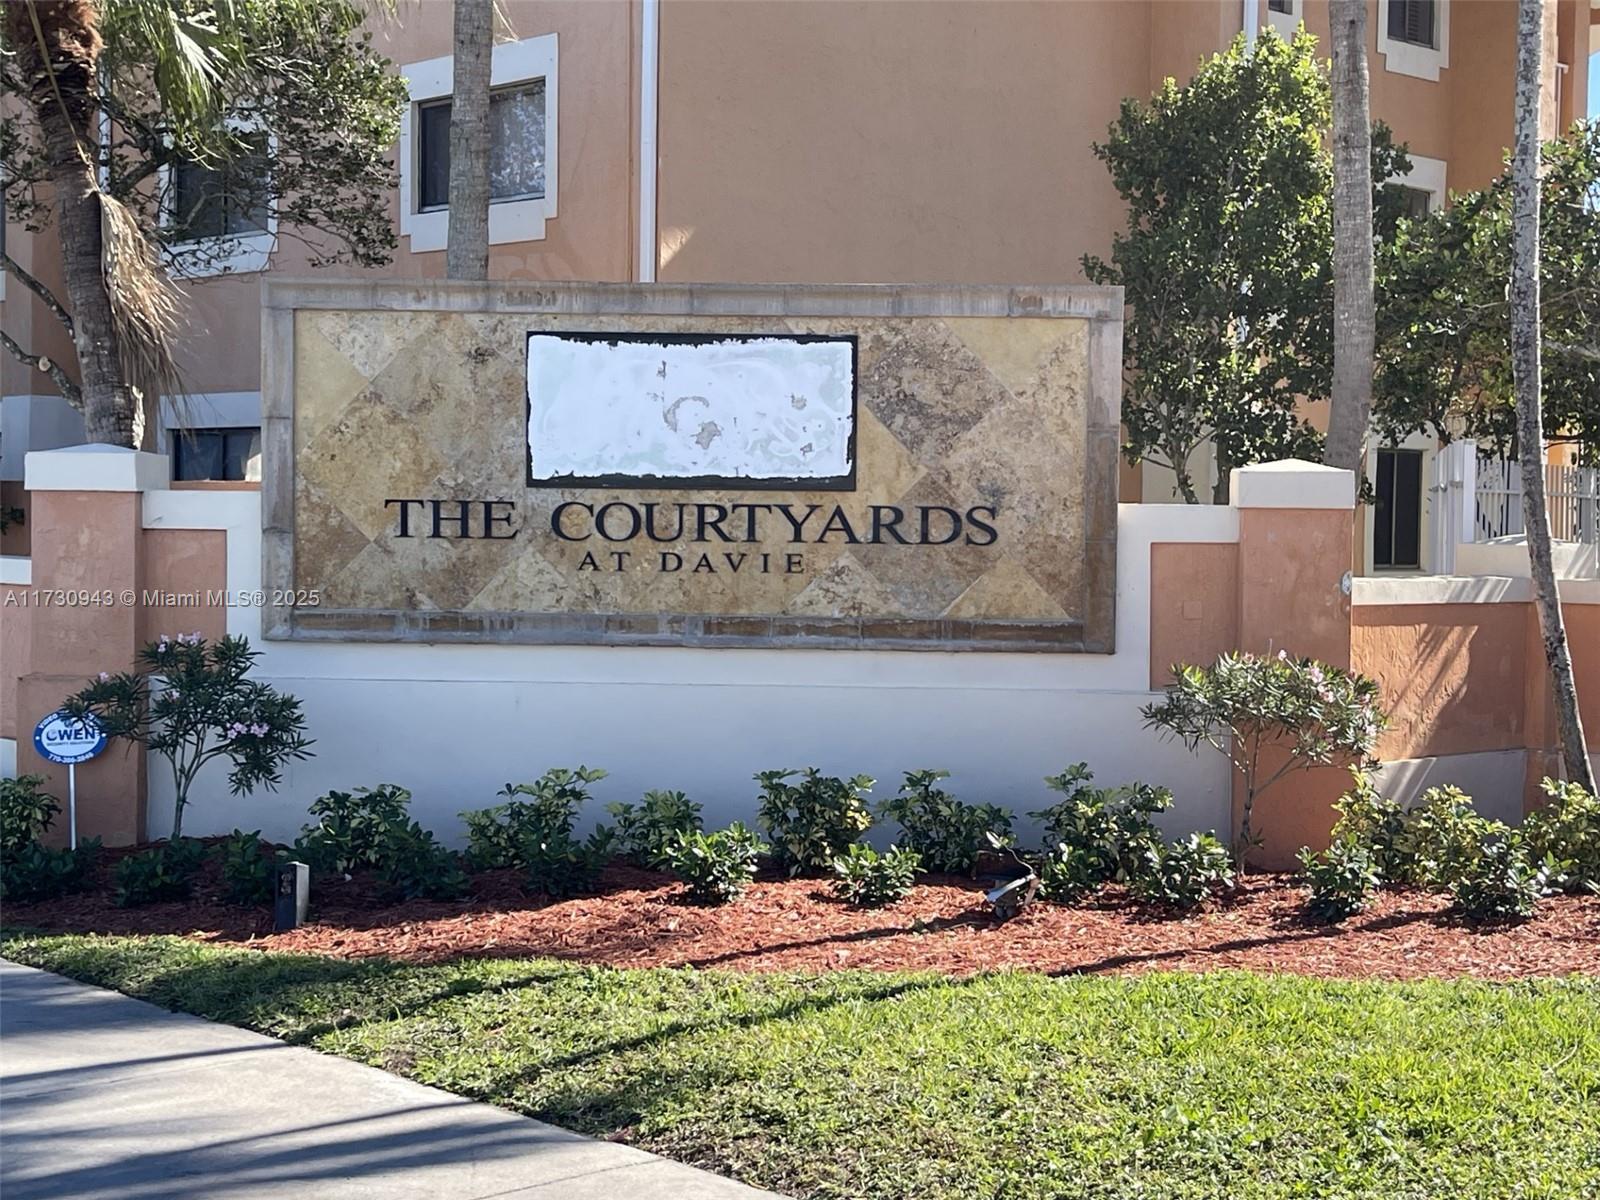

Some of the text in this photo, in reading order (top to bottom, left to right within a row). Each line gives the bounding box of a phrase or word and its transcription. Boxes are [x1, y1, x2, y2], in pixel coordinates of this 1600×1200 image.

[384, 498, 999, 546] THE COURTYARDS
[577, 550, 806, 574] AT DAVIE
